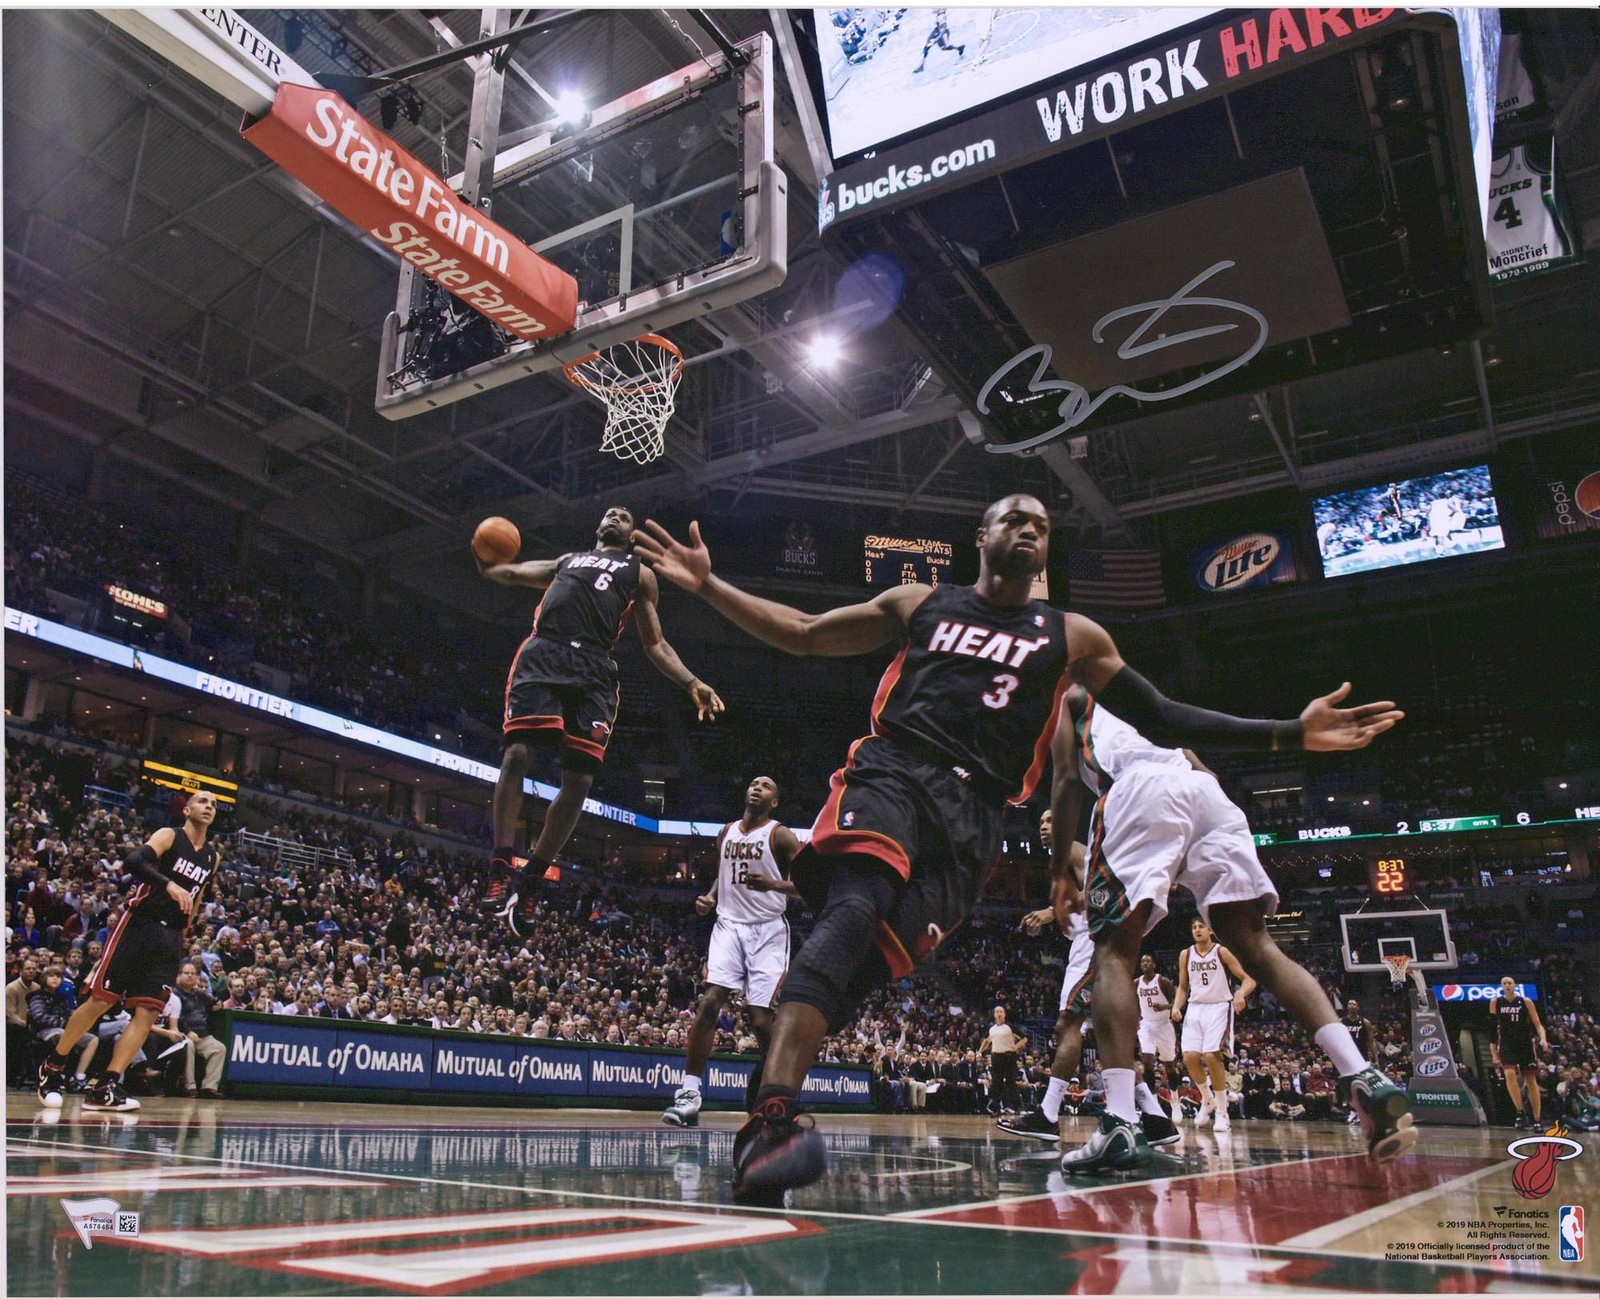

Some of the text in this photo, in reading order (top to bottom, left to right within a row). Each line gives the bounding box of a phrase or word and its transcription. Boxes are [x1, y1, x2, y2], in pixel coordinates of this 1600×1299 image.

[1036, 39, 1209, 142] WORK
[838, 138, 996, 213] bucks.com
[306, 98, 510, 274] State Farm
[1493, 196, 1523, 230] 4
[1489, 244, 1549, 269] Moncrief
[1501, 244, 1530, 257] SIDNEY
[370, 222, 470, 287] State
[457, 280, 546, 335] Farm
[1495, 261, 1550, 281] 1979-1989
[1547, 481, 1577, 525] pepsi
[917, 539, 941, 548] TEAM
[923, 546, 950, 556] STATS
[567, 555, 629, 573] HEAT
[785, 549, 816, 566] BUCKS
[865, 550, 951, 566] Heat Bucks
[865, 560, 938, 574] 0 FT 0
[1214, 544, 1272, 588] Lite
[593, 572, 614, 591] 6
[901, 571, 917, 579] FTA
[109, 584, 166, 614] KOHL'S
[927, 620, 1051, 669] HEAT
[196, 670, 294, 720] FRONTIER
[981, 673, 1019, 710] 3
[582, 797, 637, 827] FRONTIER
[1298, 826, 1351, 840] BUCKS
[1396, 822, 1409, 834] 2
[1422, 820, 1456, 832] 8:37
[1516, 812, 1530, 825] 6
[724, 840, 764, 860] BUCKS
[172, 857, 210, 884] HEAT
[1378, 859, 1405, 872] 8:37
[1377, 872, 1404, 892] 22
[189, 885, 200, 900] 8
[1191, 959, 1218, 972] BUCKS
[1201, 972, 1208, 986] 6
[1140, 986, 1159, 997] BUCKS
[1500, 1005, 1522, 1014] HEAT
[1511, 1014, 1519, 1022] 11
[231, 1034, 424, 1076] MUTUAL of OMAHA
[437, 1050, 582, 1084] MUTUAL of OMAHA
[592, 1060, 687, 1089] MUTUAL of OMA
[1424, 1060, 1447, 1075] Lite
[834, 1075, 843, 1097] of
[843, 1076, 869, 1094] OMAHA
[1415, 1093, 1460, 1102] FRONTIER
[90, 1216, 113, 1224] Fanatics
